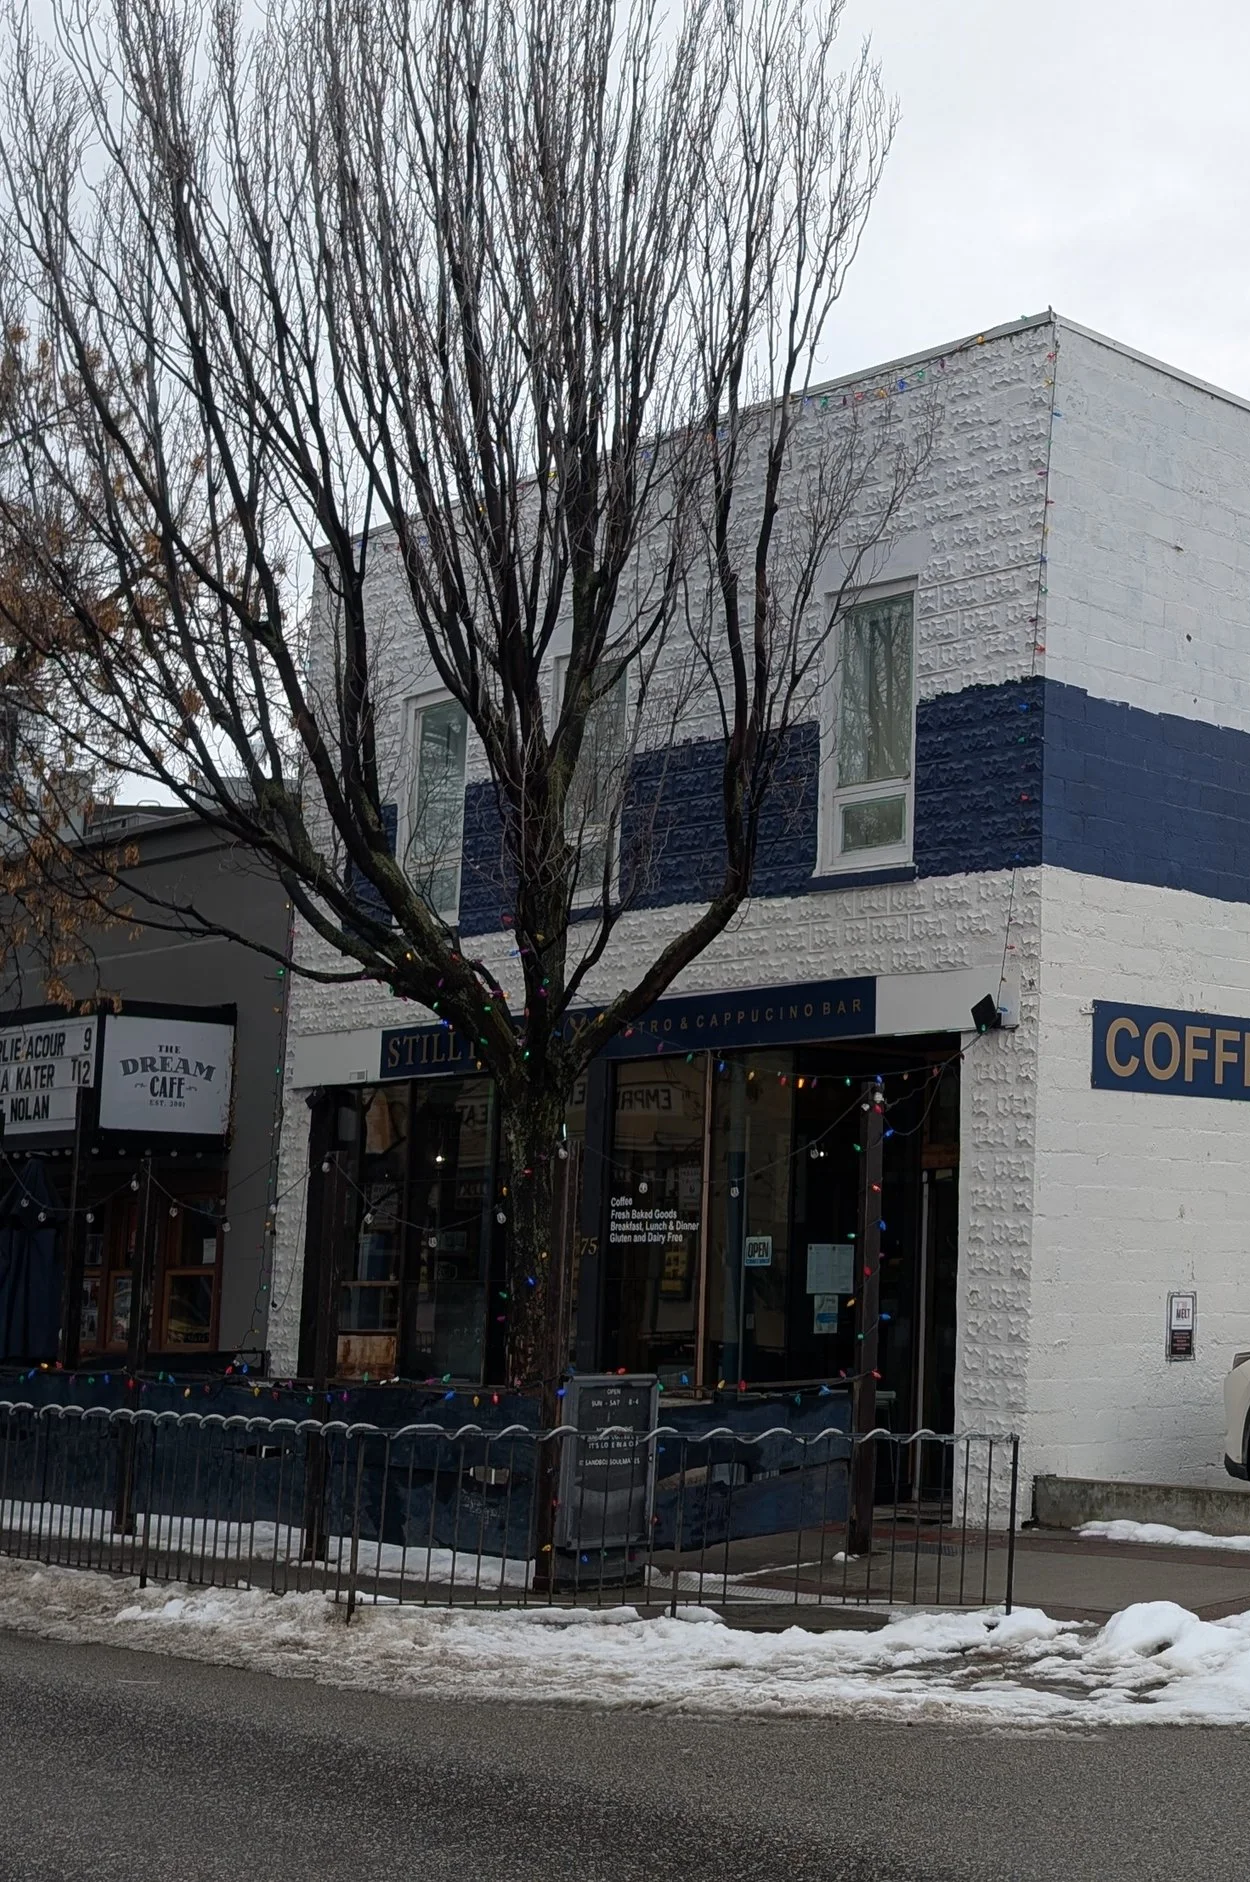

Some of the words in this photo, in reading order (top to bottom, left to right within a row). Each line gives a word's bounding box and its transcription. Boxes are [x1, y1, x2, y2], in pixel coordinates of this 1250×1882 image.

[680, 1016, 689, 1031] &
[695, 1003, 813, 1030] CAPPUCINO
[822, 998, 862, 1016] BAR
[0, 1038, 22, 1063] LIE
[83, 1027, 92, 1052] 9
[158, 1044, 181, 1054] THE
[387, 1031, 462, 1069] STILL
[15, 1063, 55, 1091] KATER
[119, 1055, 217, 1082] DREAM
[149, 1075, 186, 1100] CAFE
[10, 1094, 50, 1122] NOLAN
[610, 1196, 633, 1208] Coffee
[610, 1209, 630, 1220] Fresh
[631, 1208, 653, 1220] Baked
[654, 1208, 678, 1220] Goods
[610, 1220, 643, 1232] Breakfast,
[645, 1220, 667, 1231] Lunch
[668, 1220, 675, 1231] &
[676, 1220, 700, 1231] Dinner
[580, 1236, 600, 1256] 75
[609, 1232, 632, 1244] Gluten
[633, 1232, 647, 1243] and
[648, 1231, 666, 1245] Dairy
[667, 1231, 684, 1243] Free
[747, 1242, 769, 1258] OPEN
[606, 1388, 621, 1396] OPEN
